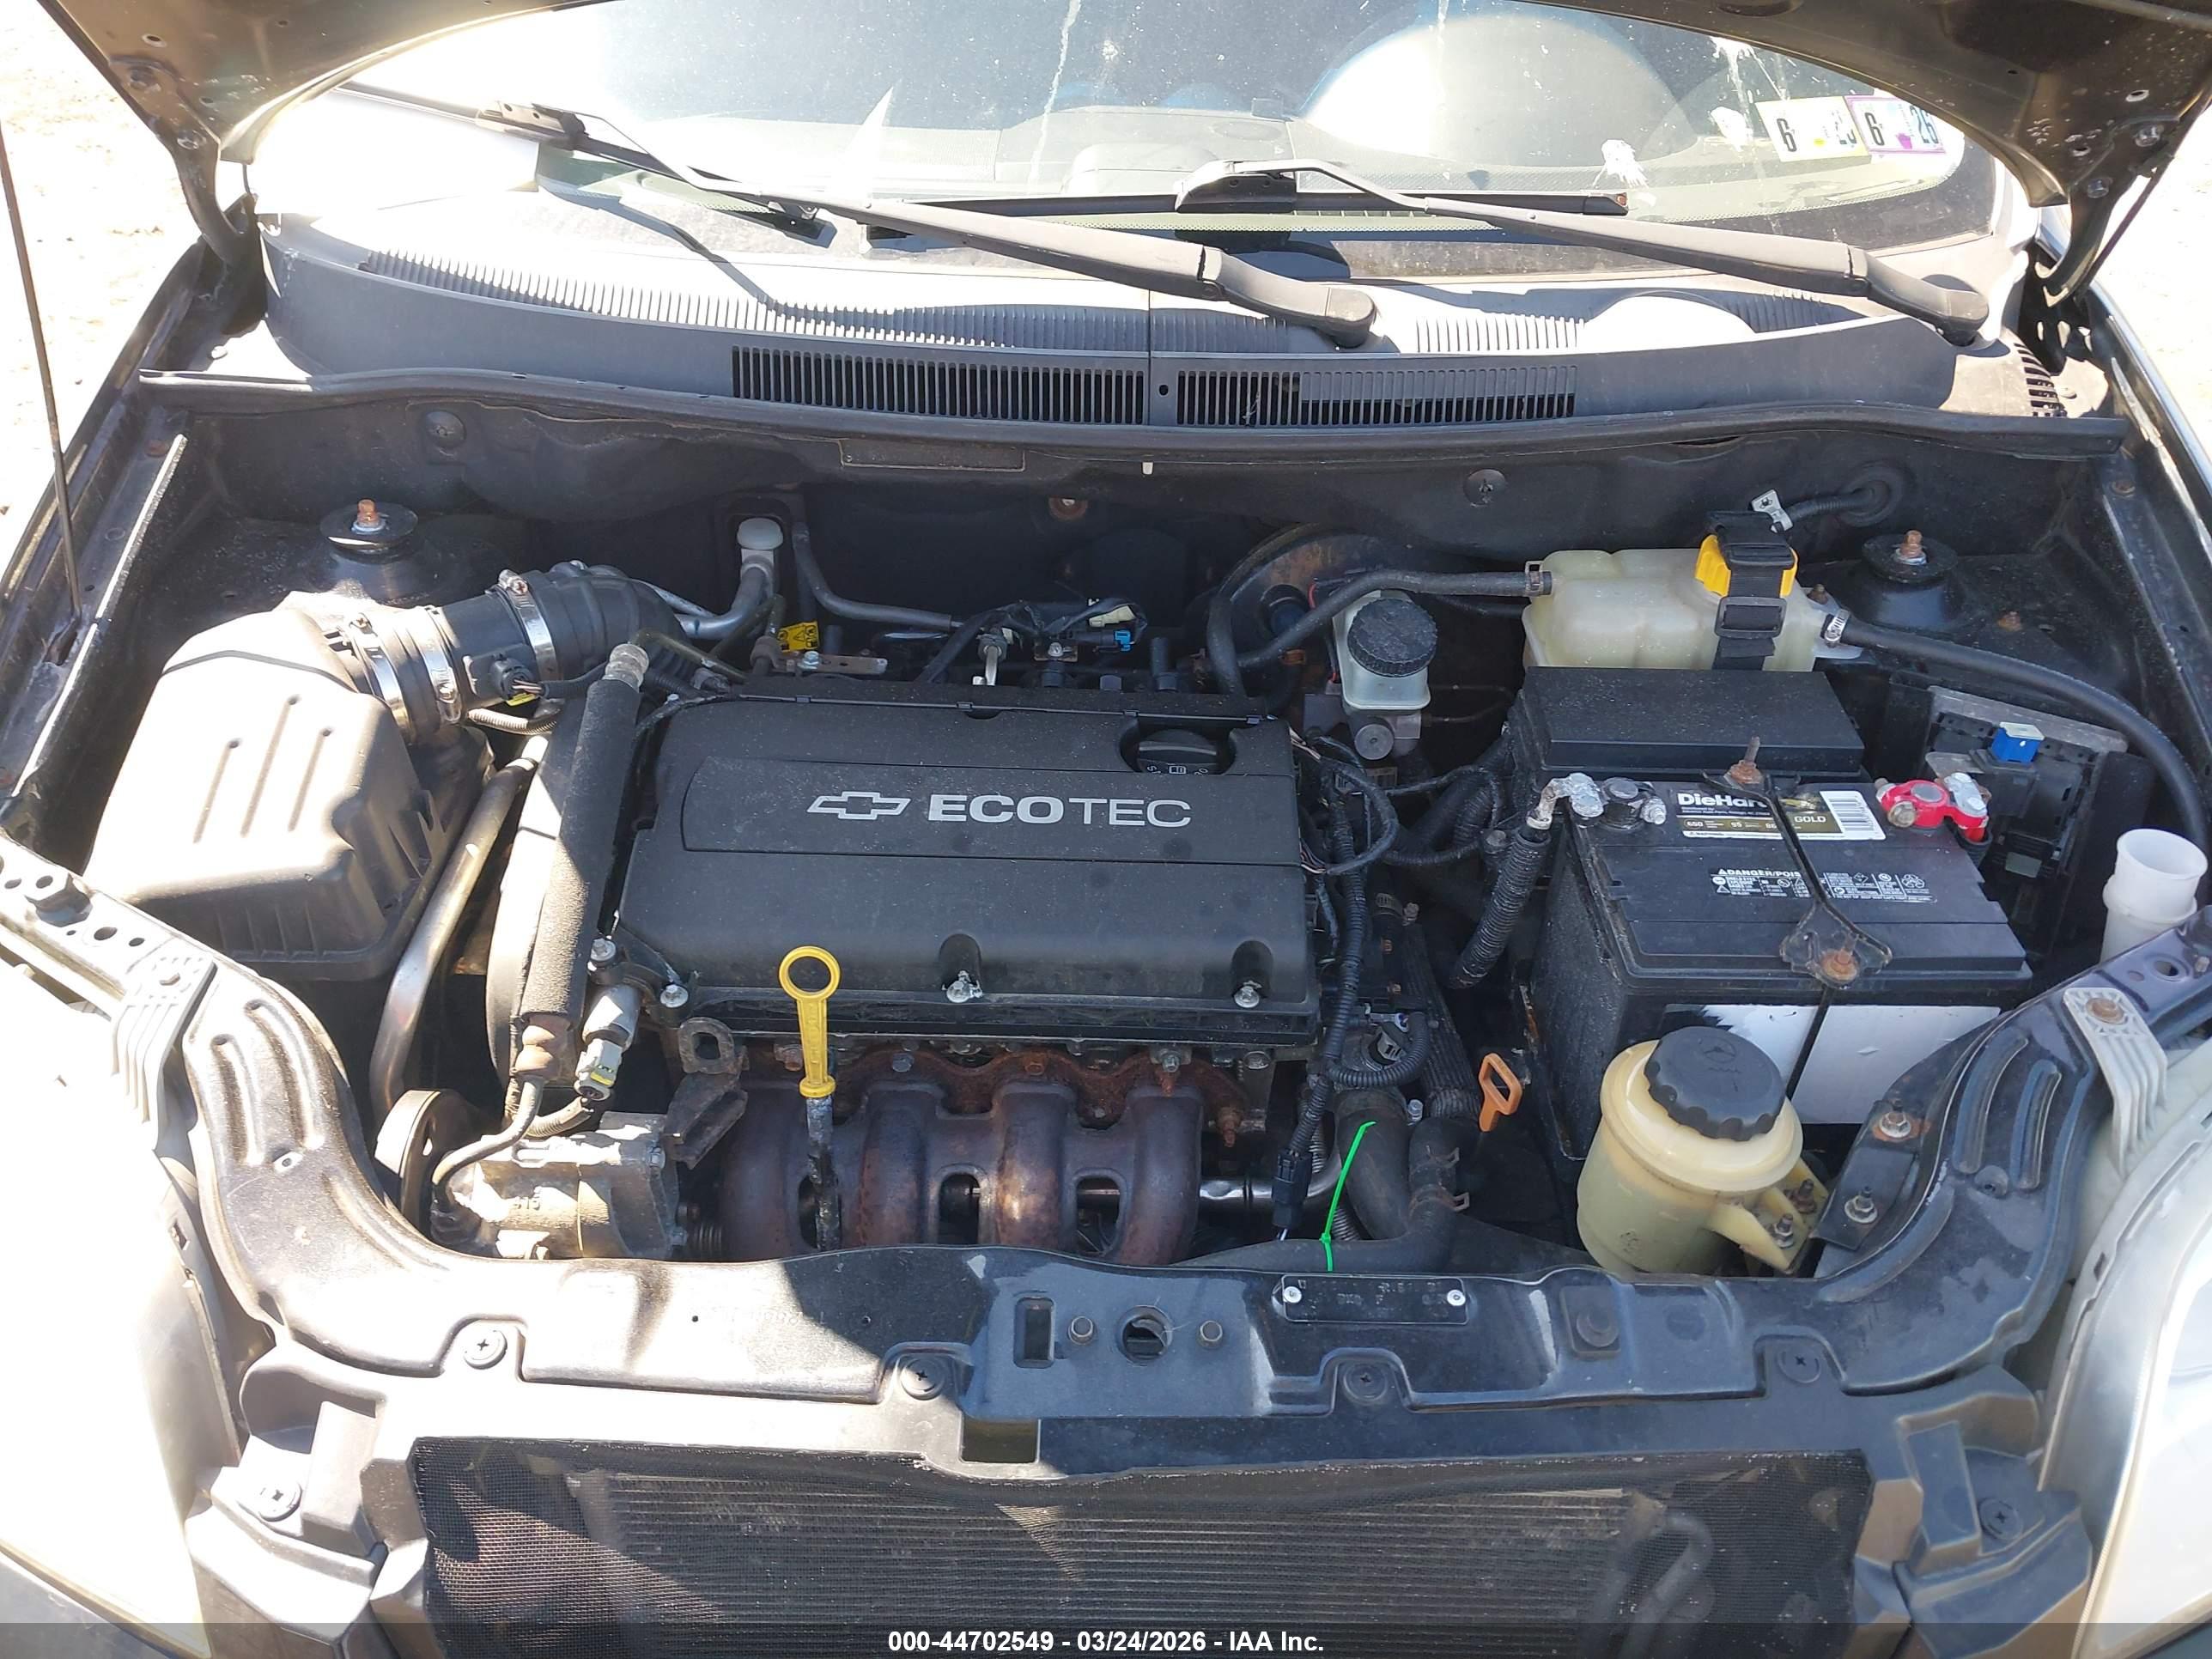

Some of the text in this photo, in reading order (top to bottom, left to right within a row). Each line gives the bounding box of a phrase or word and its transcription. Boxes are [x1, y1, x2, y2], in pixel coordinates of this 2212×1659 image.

[1776, 118, 1797, 153] 6
[1864, 112, 1885, 146] 6
[927, 793, 1193, 828] ECOTEC
[1676, 792, 1767, 808] DieHar
[1726, 868, 1802, 878] DANGER/POIS
